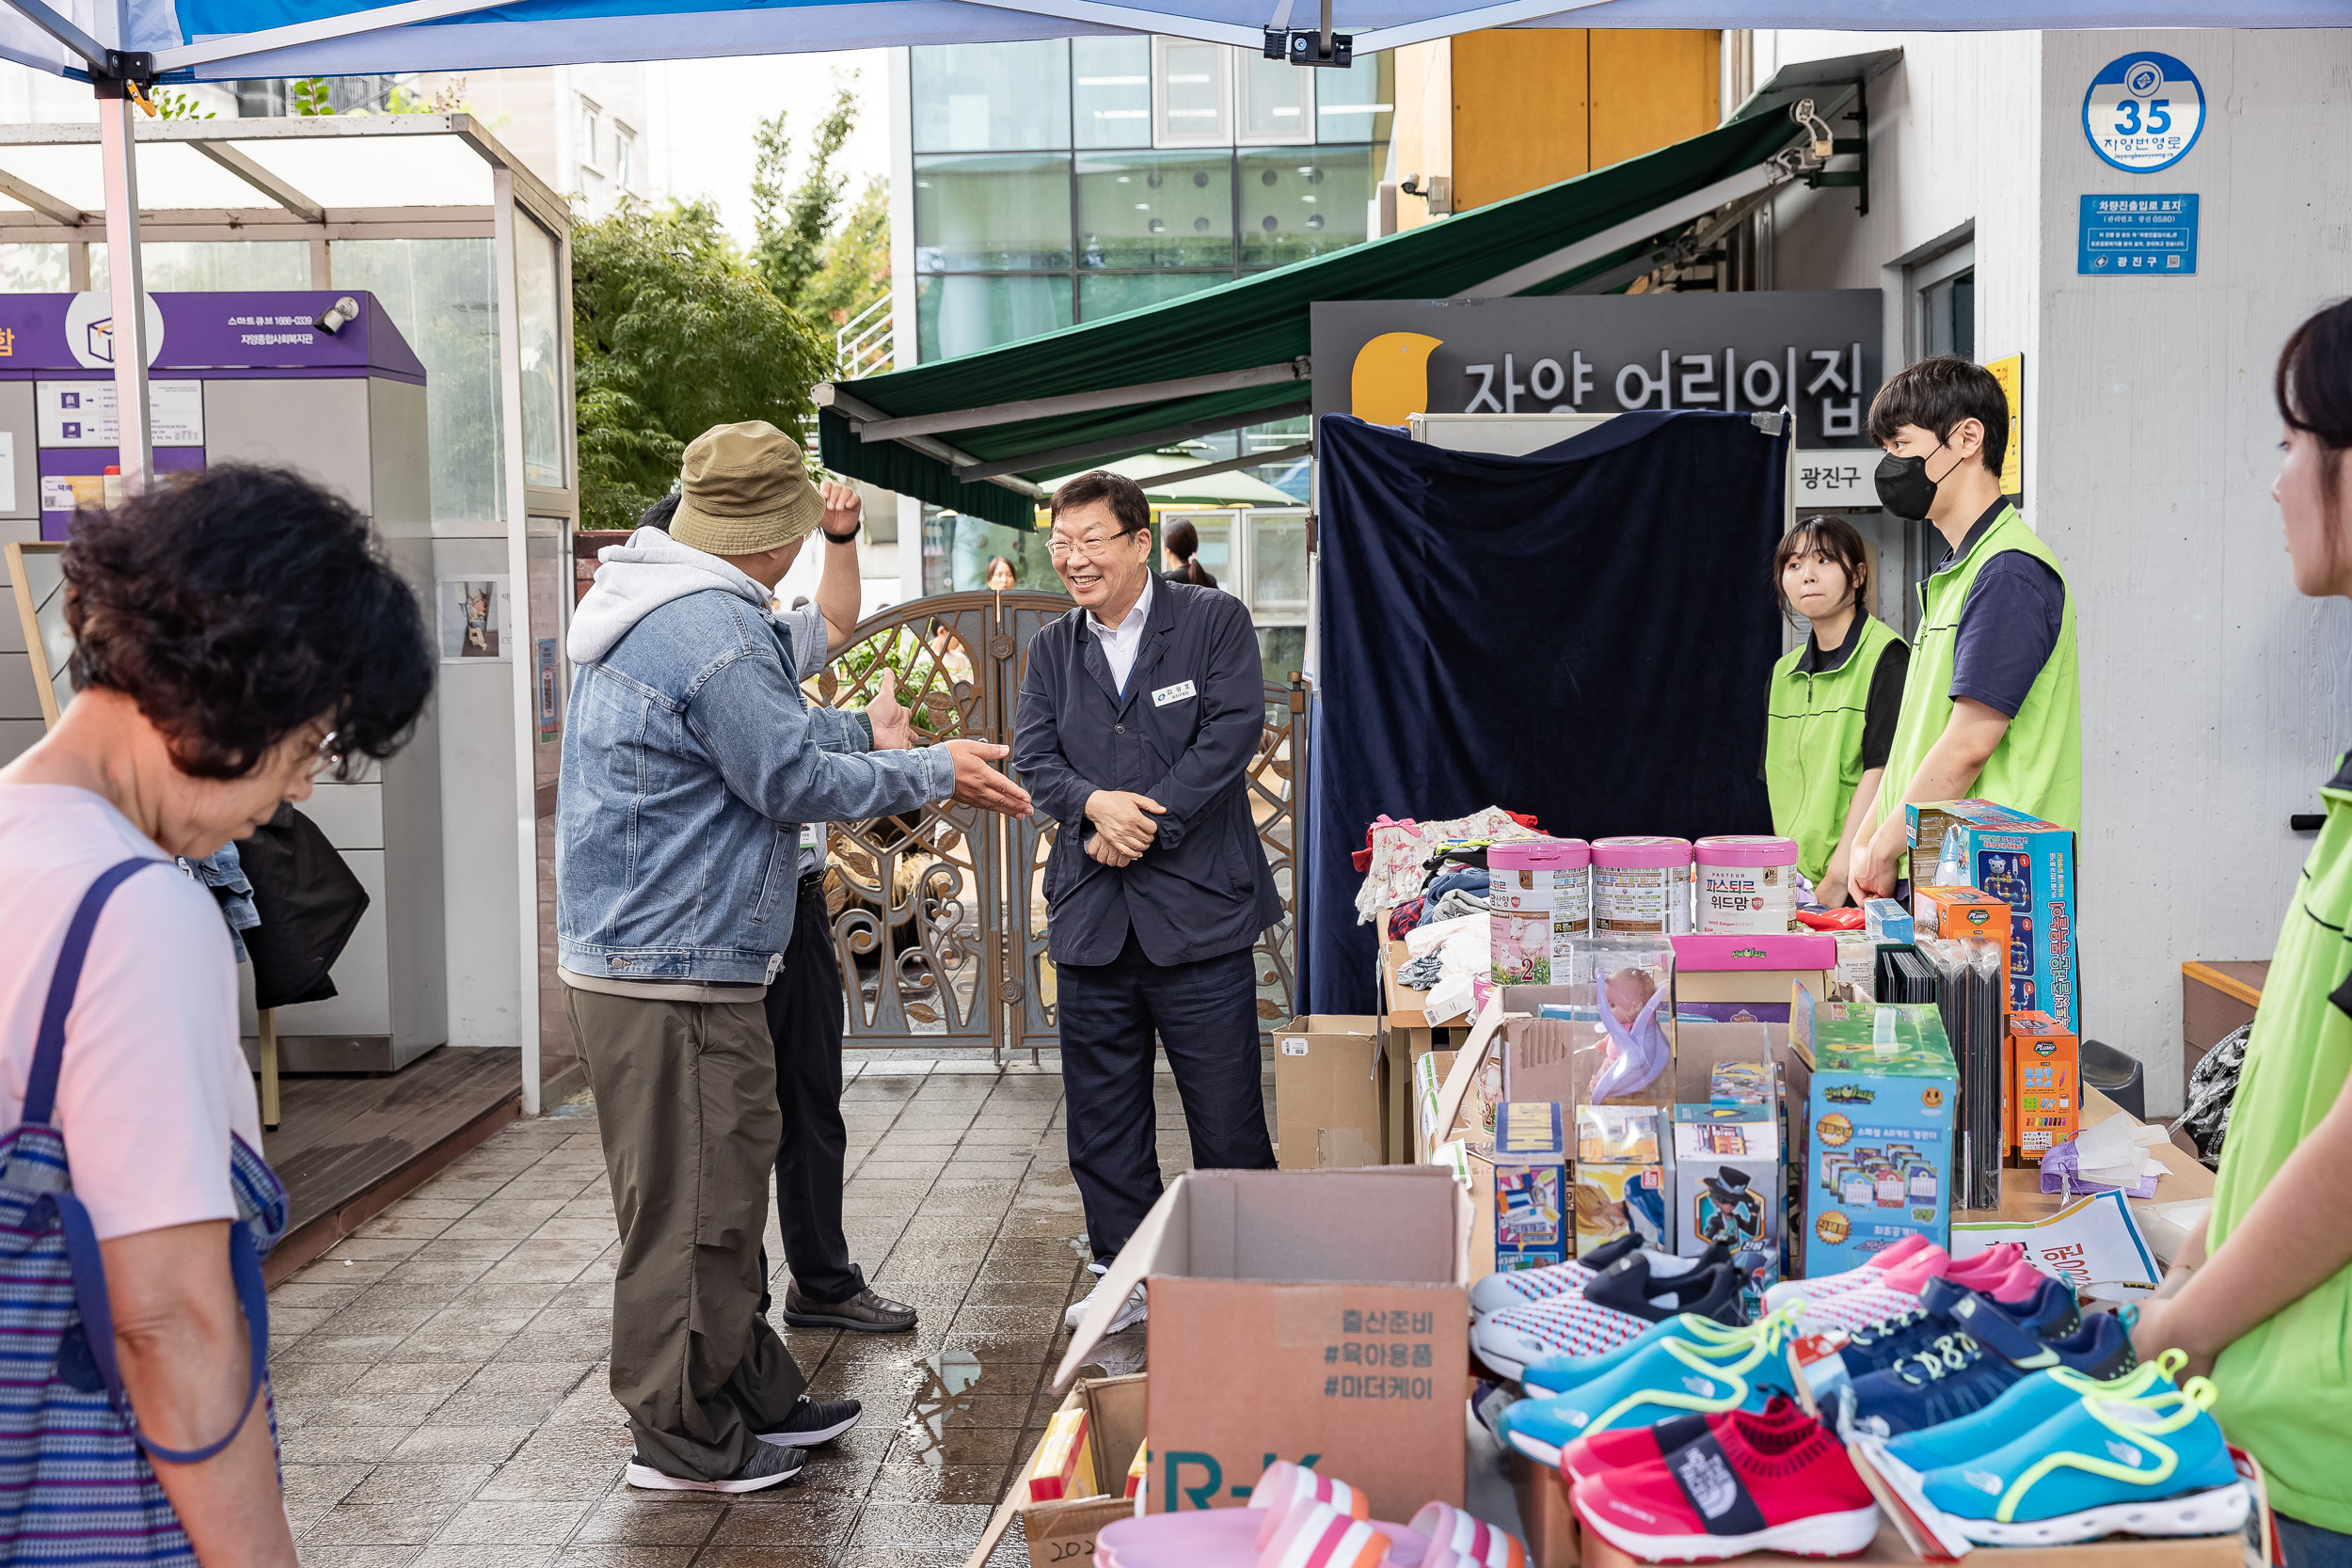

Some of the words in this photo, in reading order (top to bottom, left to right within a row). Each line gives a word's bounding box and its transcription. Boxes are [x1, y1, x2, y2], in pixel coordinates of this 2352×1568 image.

[2115, 99, 2171, 135] 35
[2105, 136, 2181, 151] 자양번영로
[2099, 199, 2159, 212] 차량진출입로
[2161, 199, 2182, 212] 표지
[1464, 350, 1594, 414] 자양
[1614, 341, 1863, 438] 어린이집
[1800, 466, 1862, 490] 광진구
[1706, 879, 1756, 894] 파스퇴르
[1711, 895, 1750, 911] 위드맘
[2047, 900, 2071, 956] 목욕놀이
[1521, 958, 1534, 981] 2
[2049, 956, 2072, 995] 즐거운
[2054, 994, 2072, 1027] 옥토넛
[1485, 1103, 1492, 1126] 2
[1342, 1308, 1434, 1335] 출산준비
[1324, 1342, 1434, 1369] #육아용품
[1324, 1374, 1433, 1400] #마더케이
